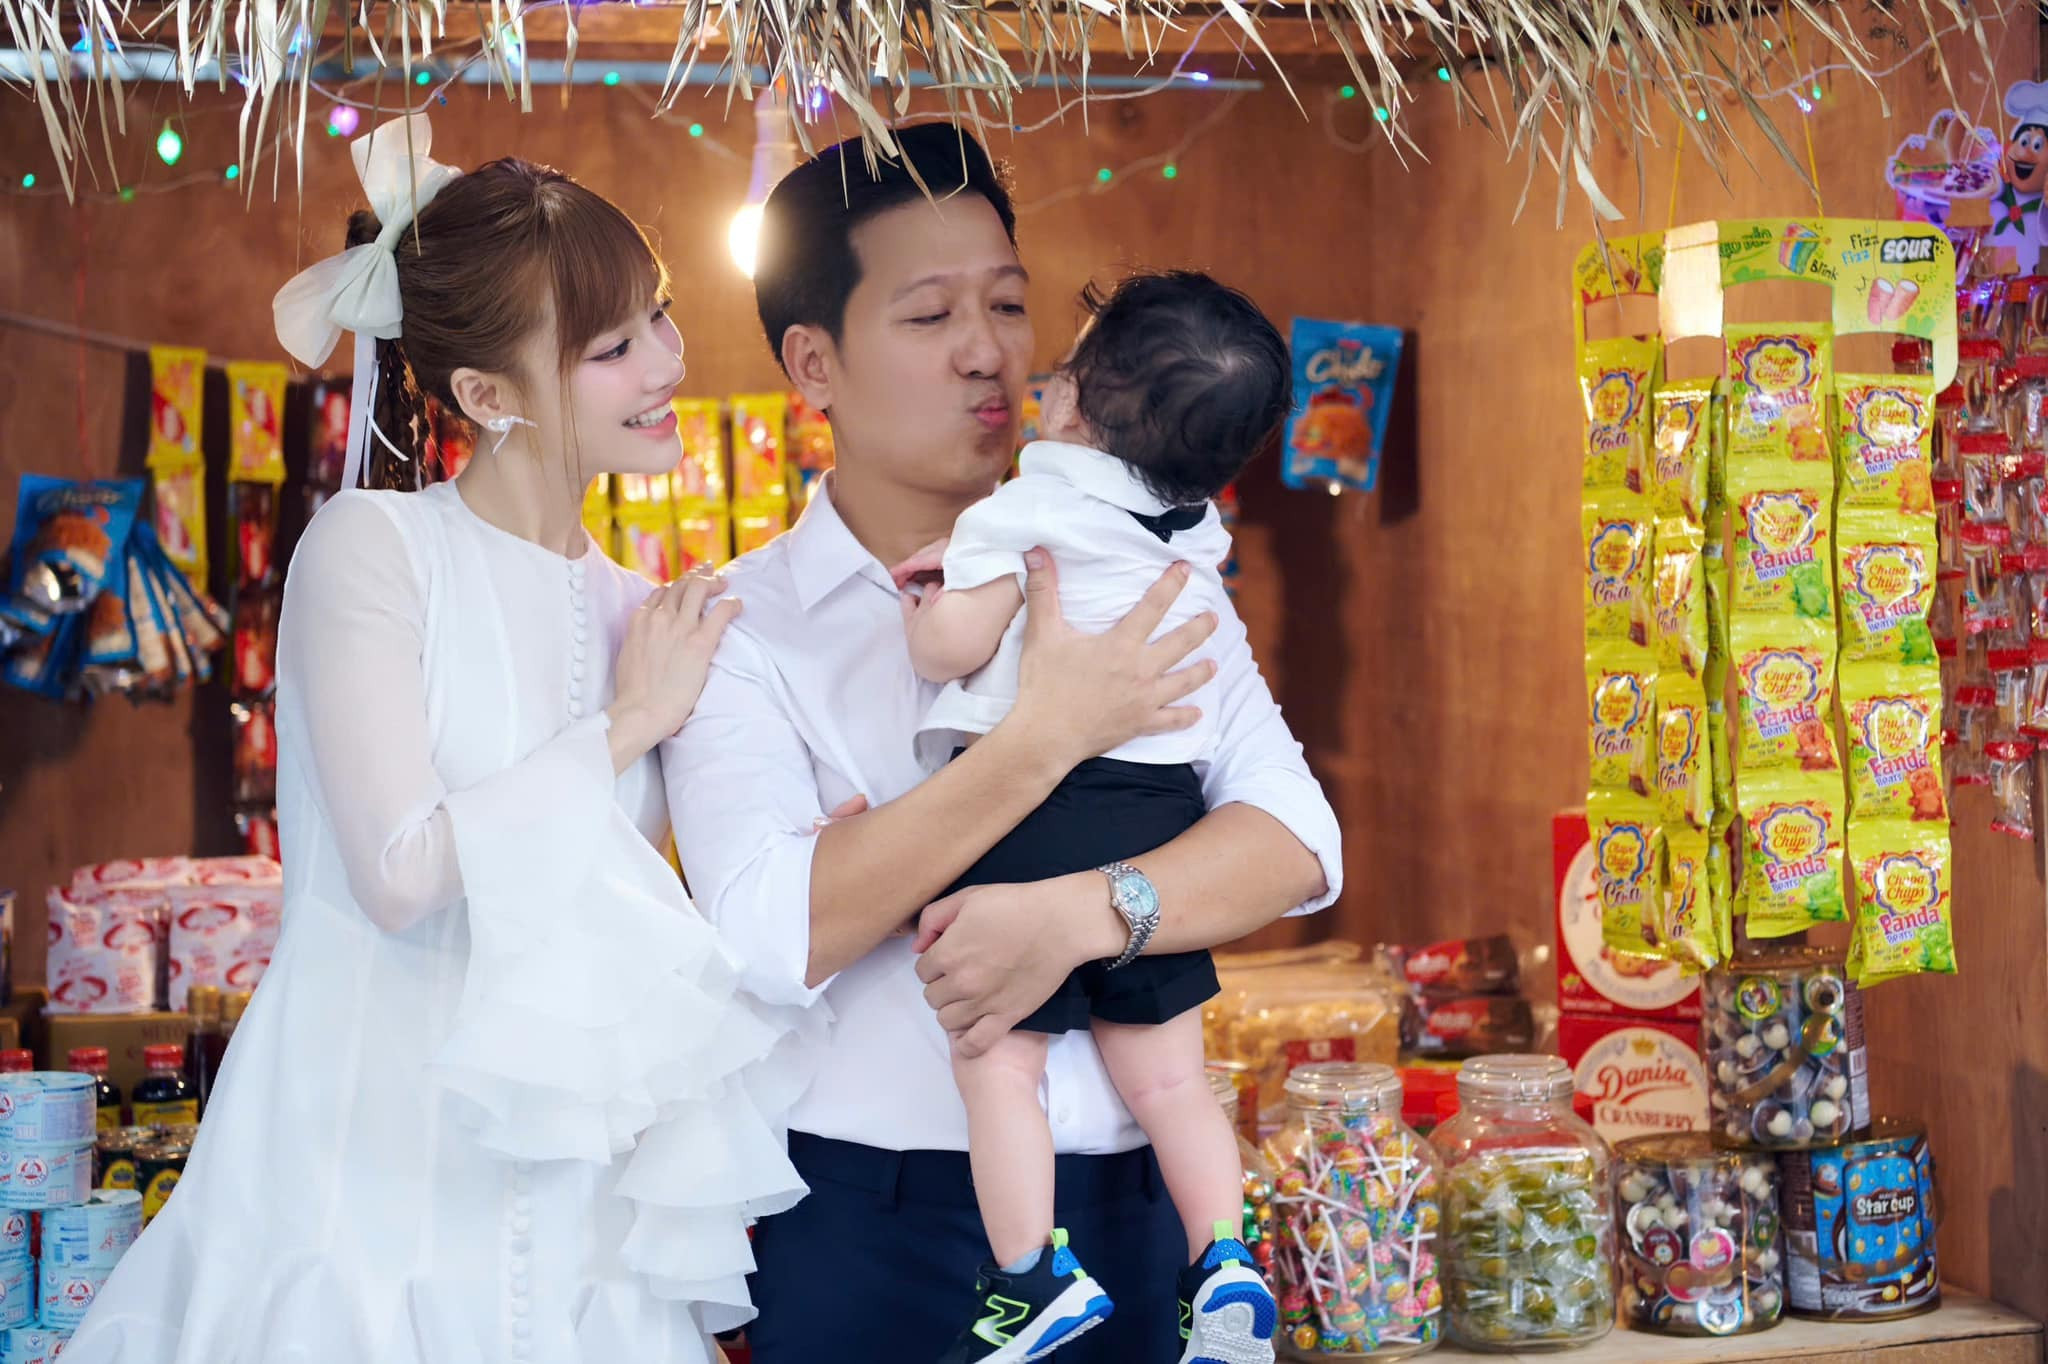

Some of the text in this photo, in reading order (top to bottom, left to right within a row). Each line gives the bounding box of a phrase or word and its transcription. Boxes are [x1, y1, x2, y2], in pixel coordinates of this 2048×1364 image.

[1882, 238, 1932, 262] SOUR
[1750, 545, 1815, 571] Panda
[1860, 595, 1922, 623] Panda
[1764, 670, 1804, 684] Chupa
[1753, 700, 1817, 728] Panda
[1774, 822, 1813, 836] Chupa
[1773, 835, 1812, 855] Chups
[1764, 853, 1827, 883] Panda
[1887, 874, 1925, 887] Chupa
[1886, 886, 1925, 906] Chups
[1879, 905, 1940, 936] Panda
[1594, 1057, 1693, 1102] Danisa
[1600, 1104, 1697, 1132] CRANBERRY
[1856, 1197, 1889, 1216] Star
